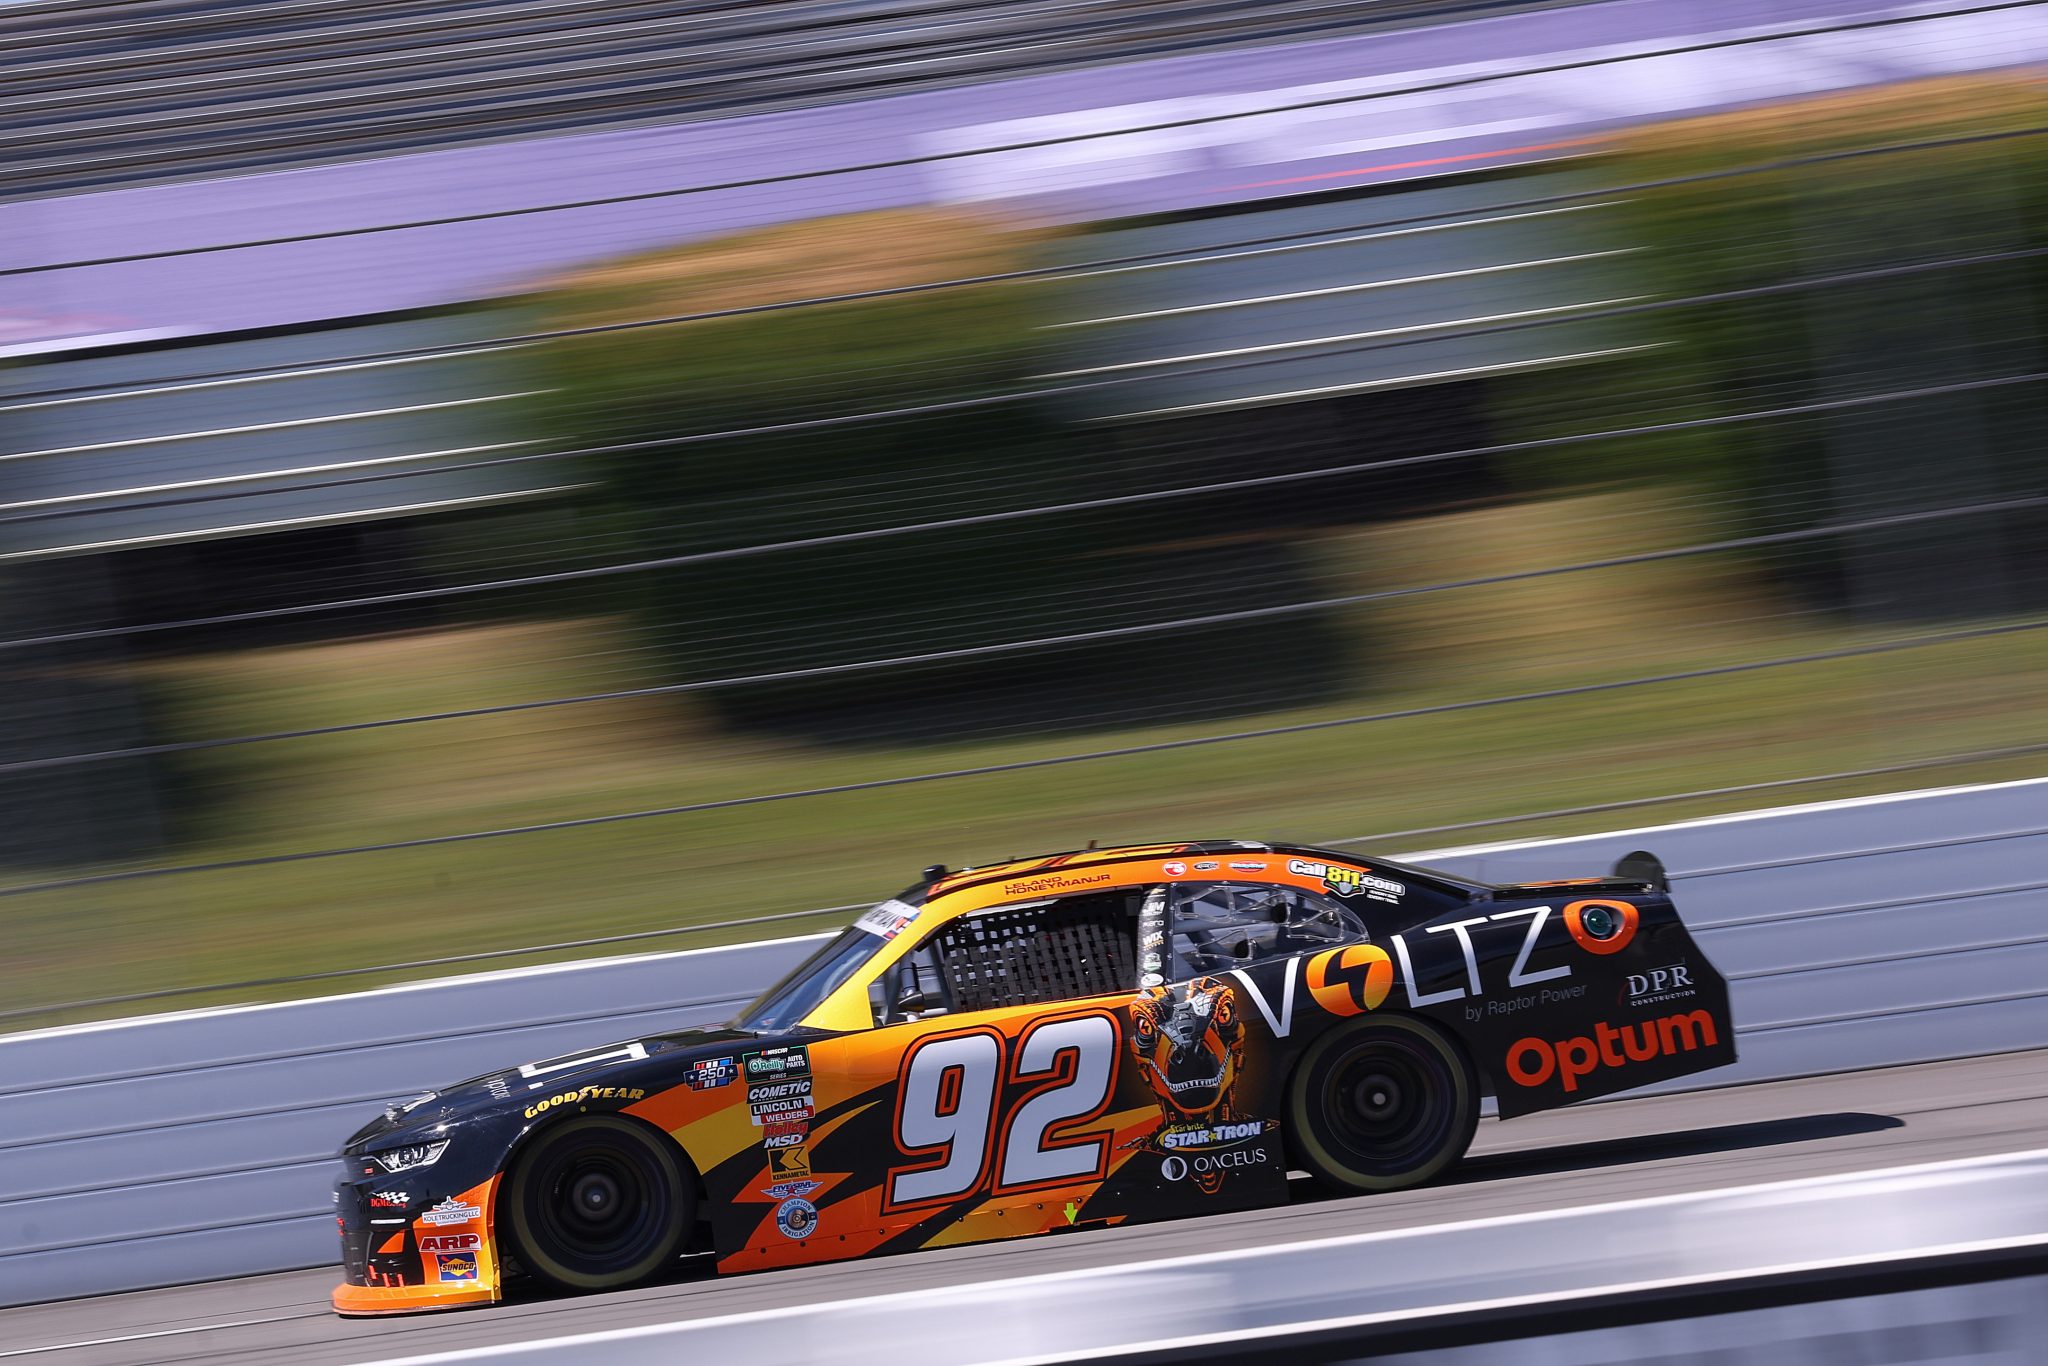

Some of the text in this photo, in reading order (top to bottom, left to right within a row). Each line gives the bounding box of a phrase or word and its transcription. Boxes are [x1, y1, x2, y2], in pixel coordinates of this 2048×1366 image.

[1005, 876, 1062, 890] LELAND
[1143, 931, 1164, 945] WIX
[1625, 966, 1694, 996] DPR
[1465, 984, 1588, 1022] by Raptor Power
[1631, 989, 1696, 1007] CONSTRUCTION
[767, 1047, 788, 1055] NASCAR
[787, 1054, 803, 1062] AUTO
[1505, 1009, 1718, 1092] Optum
[786, 1060, 806, 1068] PARTS
[698, 1066, 726, 1081] 250
[749, 1081, 811, 1100] COMETIC
[524, 1085, 645, 1119] GOODYEAR
[754, 1099, 802, 1115] LINCOLN
[766, 1110, 809, 1122] WELDERS
[885, 1011, 1119, 1210] 92
[764, 1121, 808, 1139] Holley
[764, 1134, 803, 1148] MSD
[773, 1170, 810, 1180] KENNAMETAL
[781, 1200, 813, 1215] CHAMPION
[440, 1211, 468, 1221] TRUCKING
[782, 1221, 815, 1238] IRRIGATION
[421, 1234, 479, 1250] ARP
[442, 1262, 475, 1272] SUNOCO
